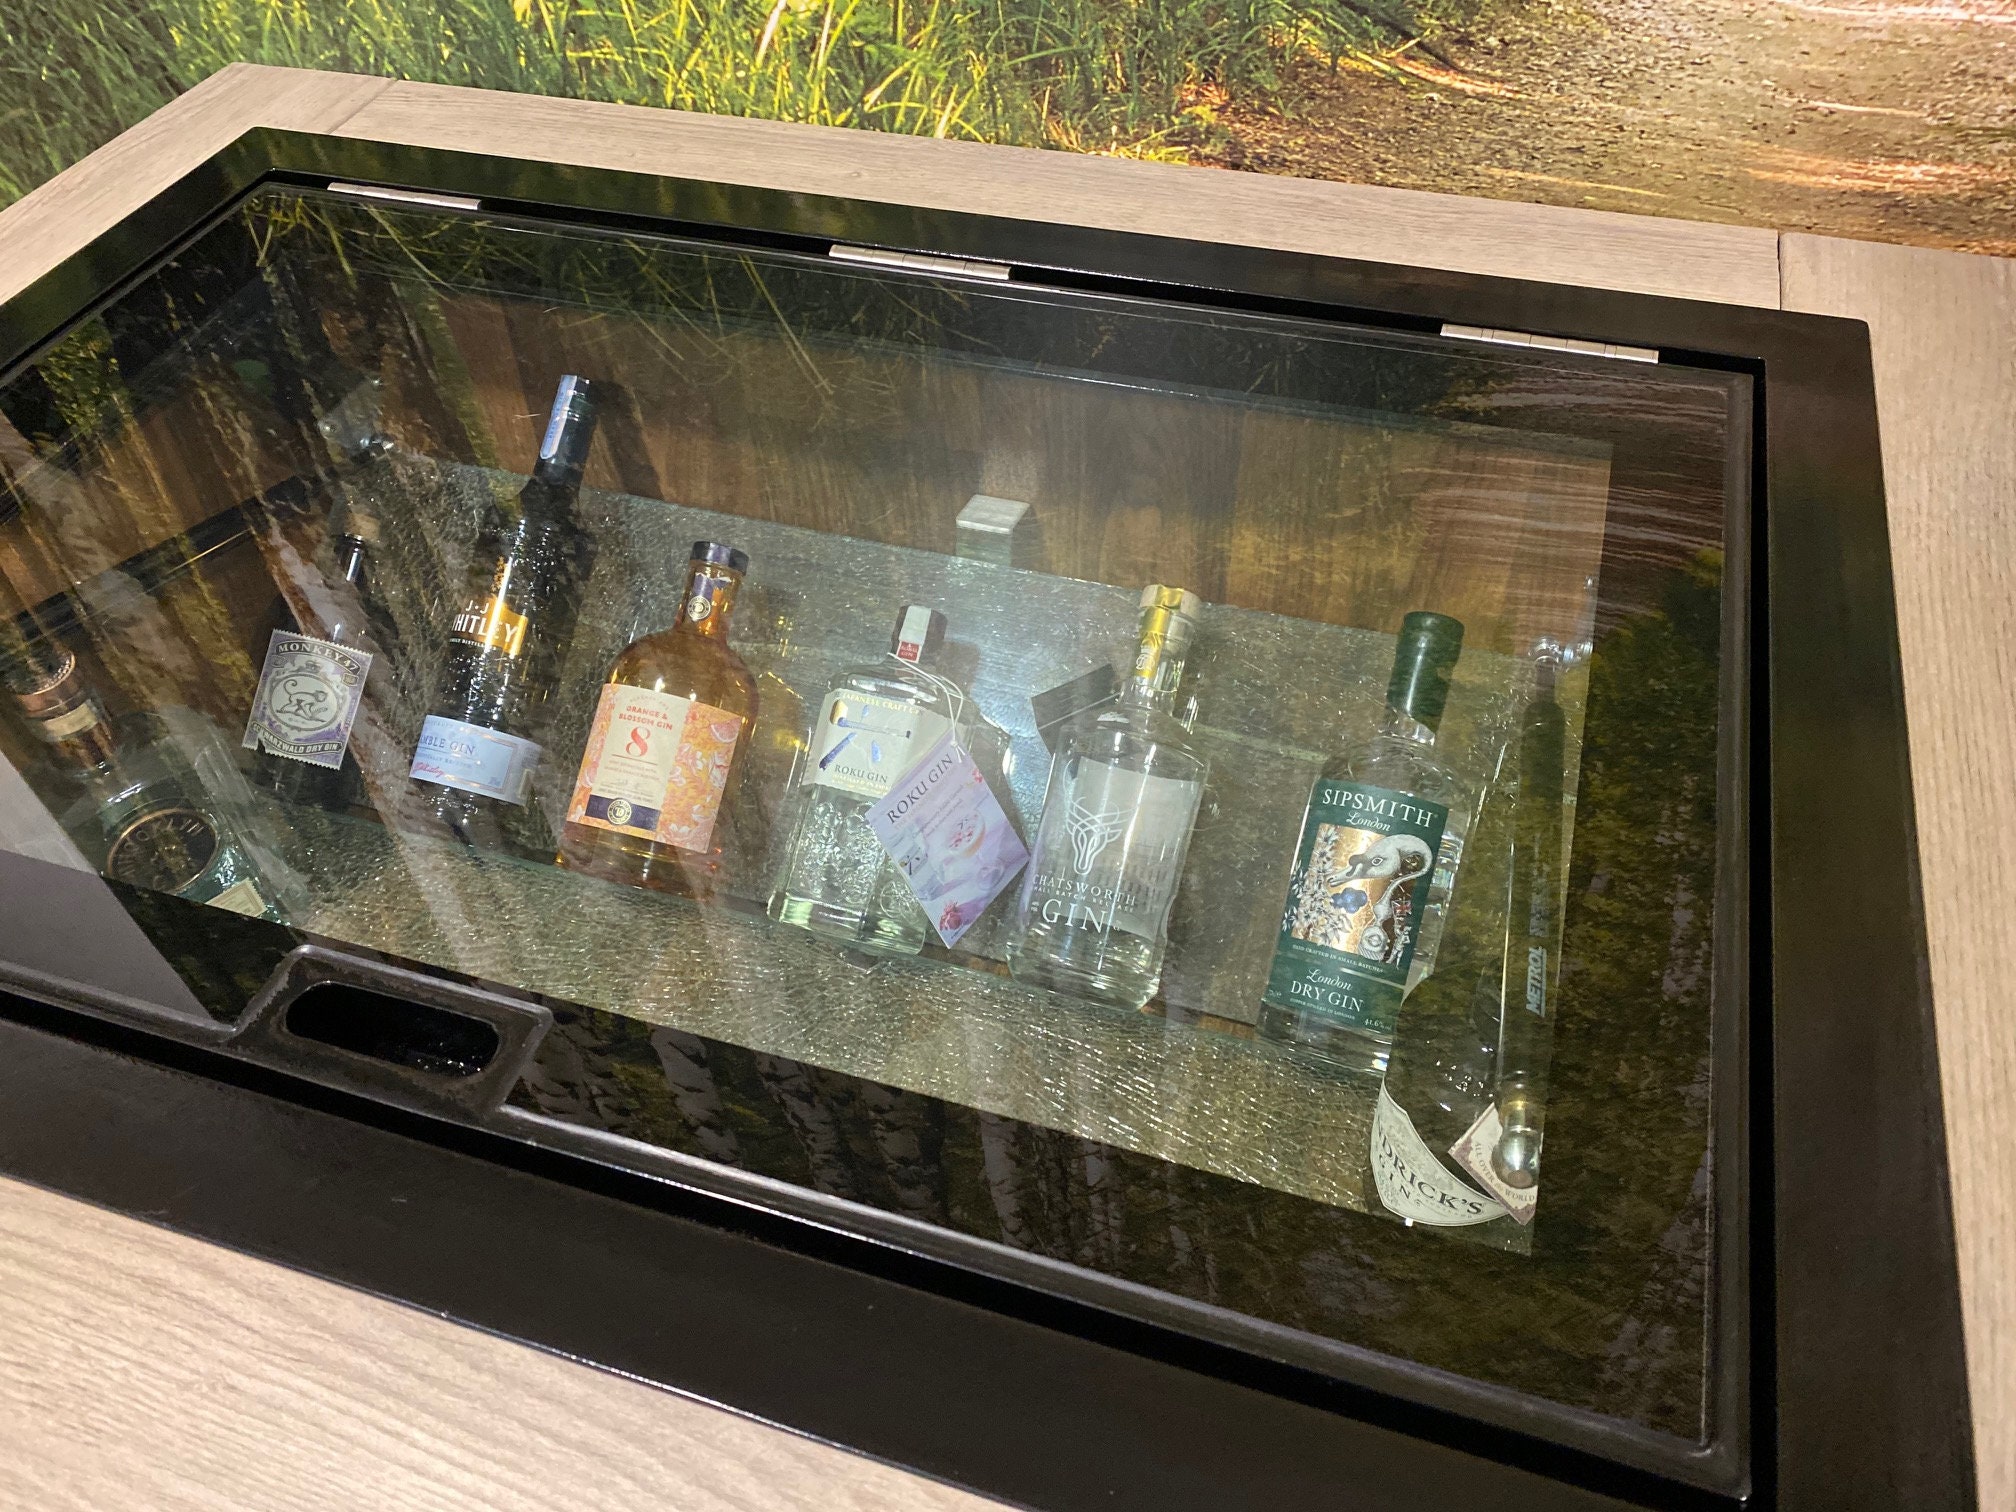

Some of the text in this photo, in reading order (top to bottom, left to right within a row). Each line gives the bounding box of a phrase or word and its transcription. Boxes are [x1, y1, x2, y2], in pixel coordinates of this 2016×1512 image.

[278, 642, 359, 671] MONKEY 47
[618, 712, 673, 731] BLOSSOM GIN
[626, 705, 668, 720] ORANGE &
[306, 744, 323, 754] DRY
[324, 742, 338, 751] GIN
[450, 741, 476, 756] GIN
[625, 726, 651, 757] 8
[834, 764, 865, 778] ROKU
[866, 771, 889, 784] GIN
[886, 780, 929, 824] ROKU
[928, 753, 953, 784] GIN
[1322, 788, 1433, 828] SIPSMITH
[1346, 810, 1392, 832] London
[1033, 867, 1136, 906] CHATSWORTH
[1055, 890, 1086, 901] BATCH
[1042, 898, 1108, 934] GIN
[1306, 967, 1353, 992] London
[1526, 946, 1544, 1015] METROL
[1290, 980, 1364, 1013] DRY GIN
[1479, 1159, 1496, 1184] OVER
[1505, 1187, 1536, 1202] WORLD
